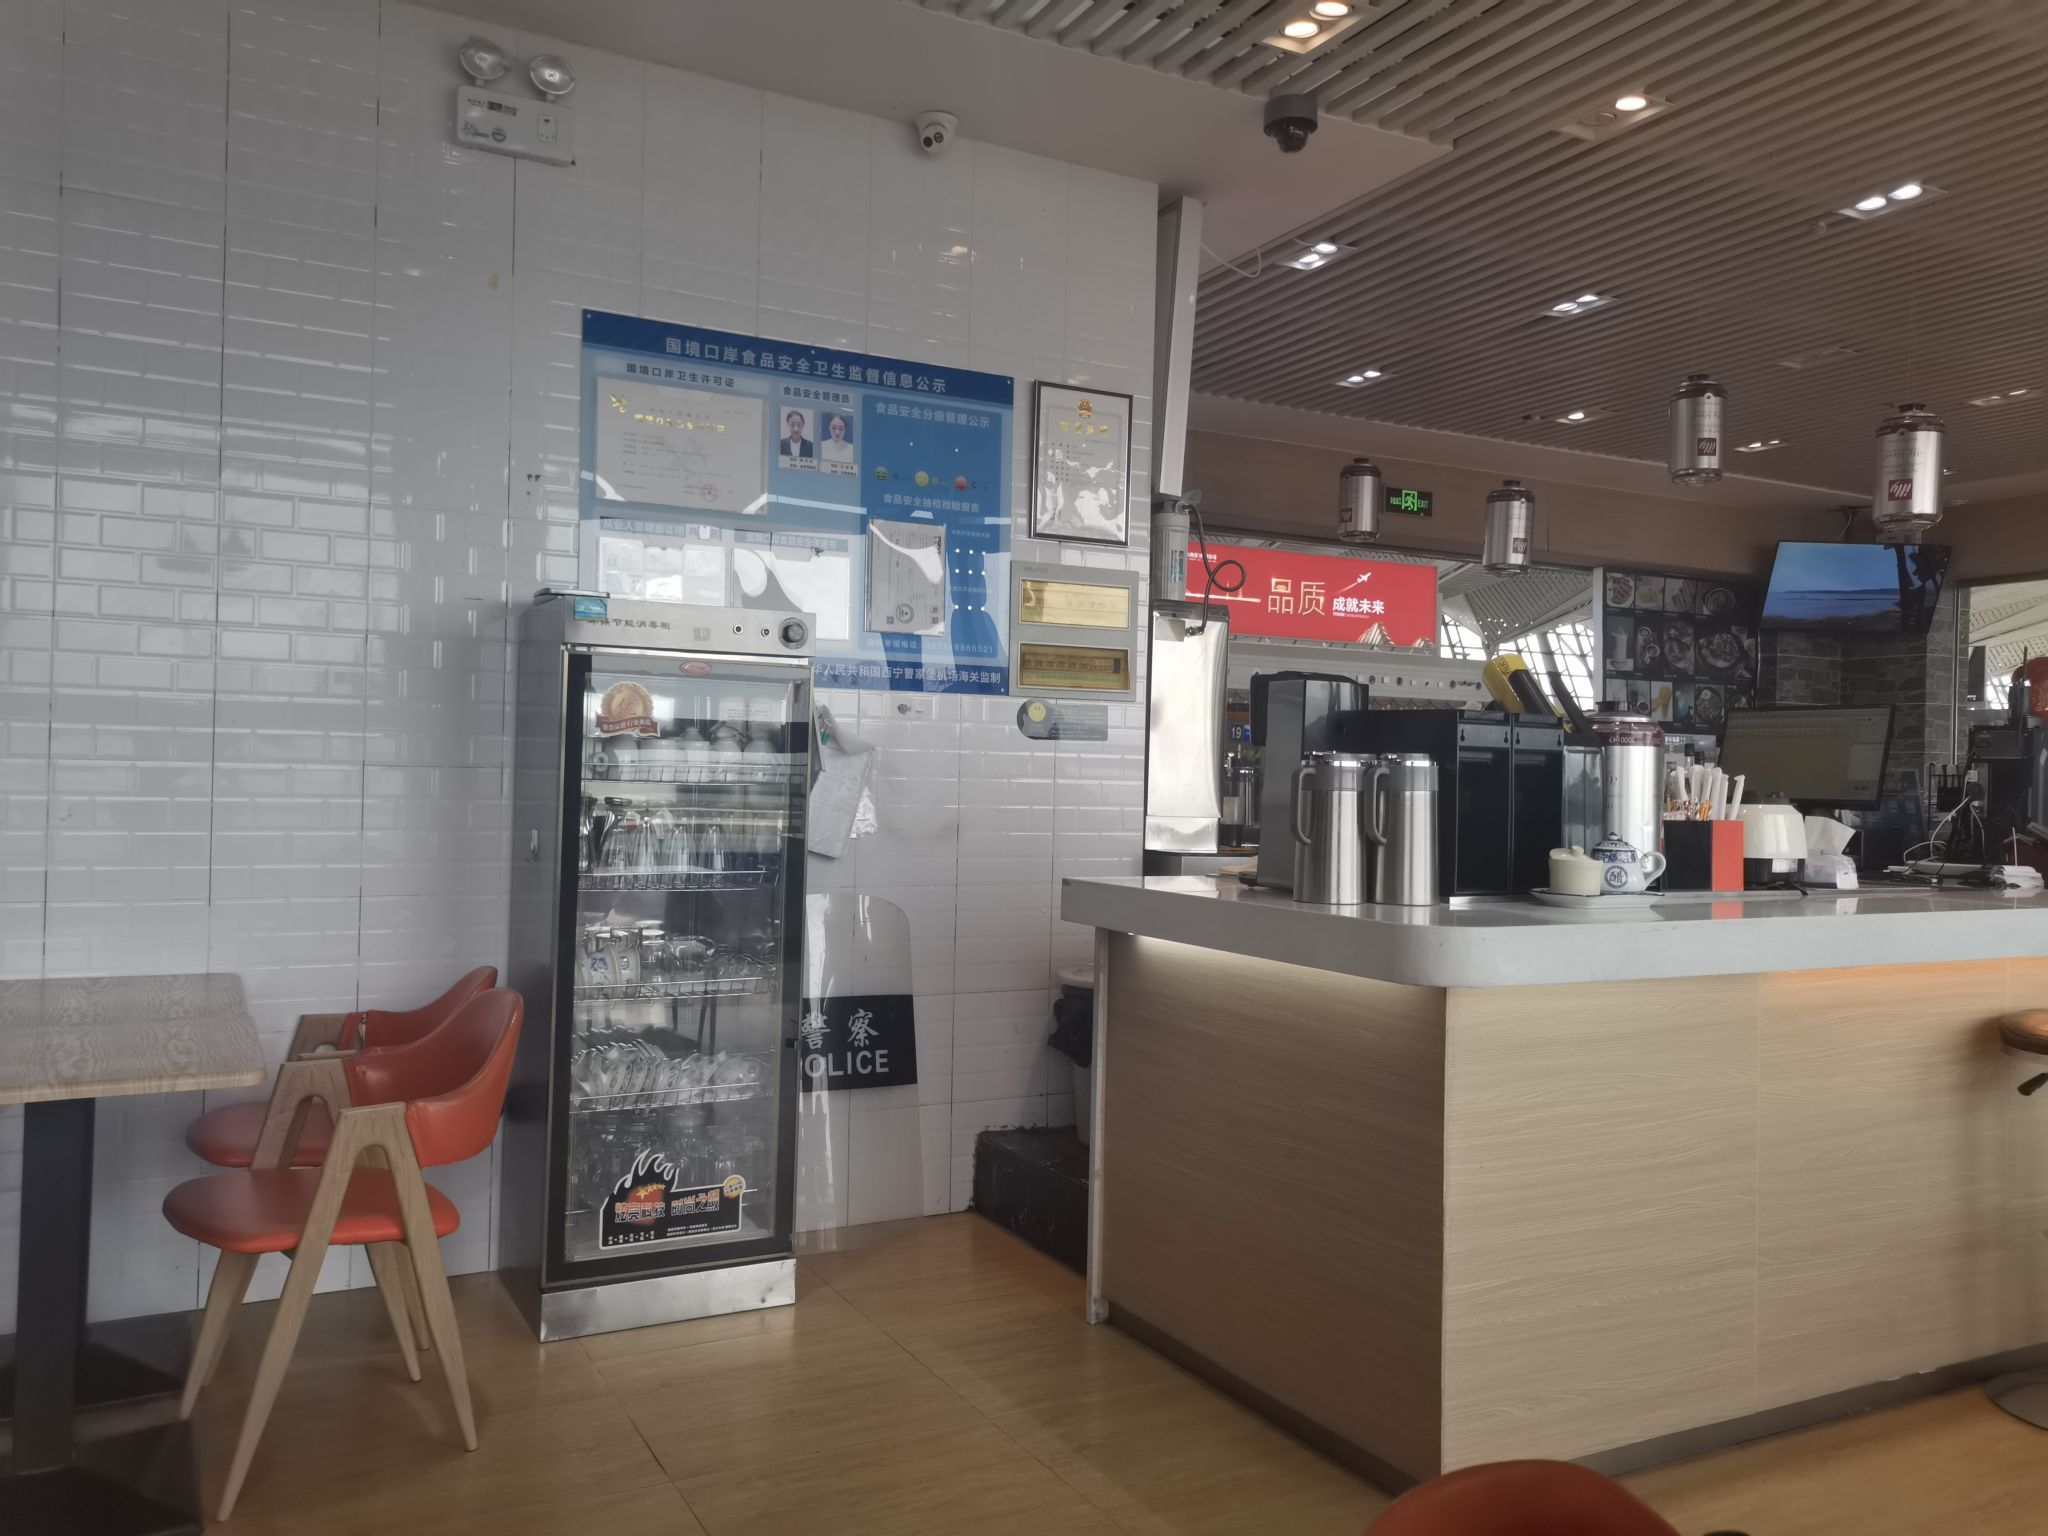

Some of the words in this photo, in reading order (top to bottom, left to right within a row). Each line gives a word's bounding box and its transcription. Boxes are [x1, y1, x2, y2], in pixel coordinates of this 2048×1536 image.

[626, 362, 735, 388] 国境口岸卫生许可证
[665, 337, 947, 393] 国境口岸食品安全卫生监督信息公示
[783, 385, 850, 404] 食品安全管理员
[875, 402, 991, 428] 食品安全分级管理公示
[1890, 480, 1912, 498] illy
[1267, 577, 1326, 616] 品质
[1332, 596, 1385, 615] 成就未来
[813, 662, 1001, 684] 华人民共和国西宁曹家堡机场海关监制
[1231, 726, 1241, 739] 19
[801, 1008, 879, 1049] 警察
[804, 1049, 889, 1078] OLICE
